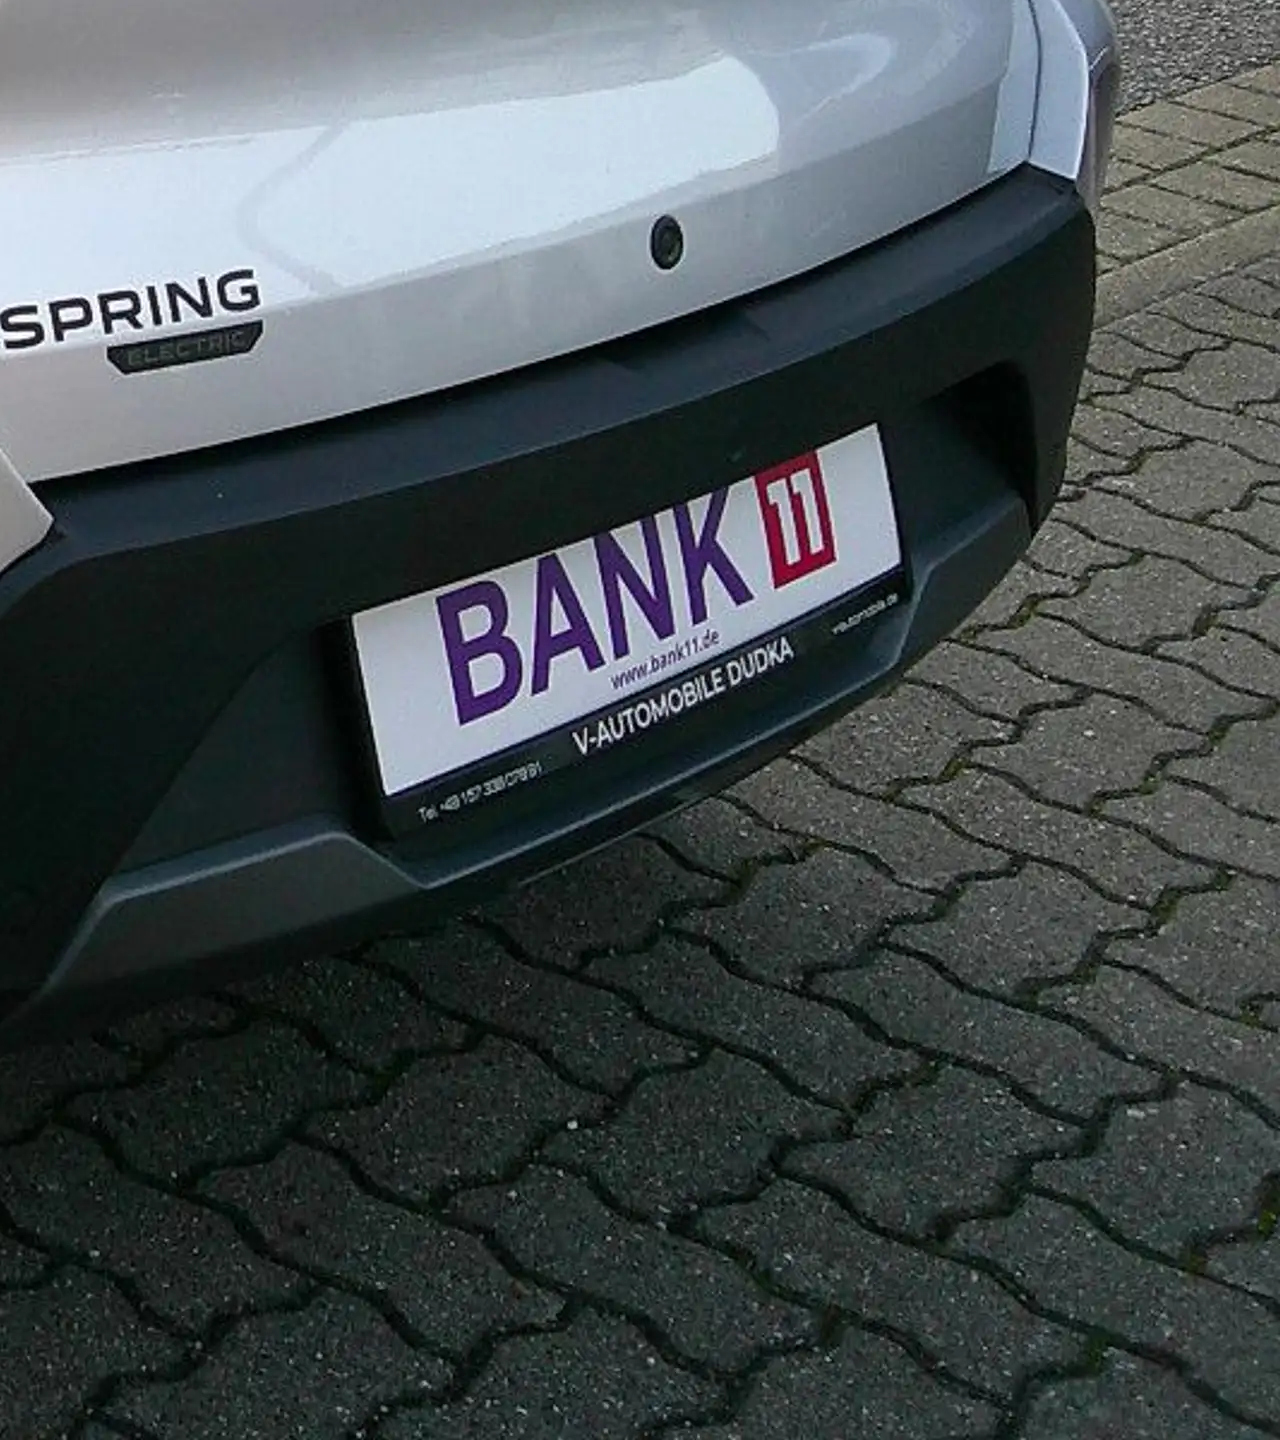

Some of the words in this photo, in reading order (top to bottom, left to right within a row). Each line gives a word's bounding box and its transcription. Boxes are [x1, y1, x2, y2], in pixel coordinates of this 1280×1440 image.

[127, 329, 246, 368] ELECTRIC
[435, 486, 755, 727] BANK
[765, 466, 827, 568] 11
[572, 669, 727, 756] V-AUTOMOBILE
[726, 635, 795, 688] DUDKA
[611, 628, 720, 690] www.bank11.de
